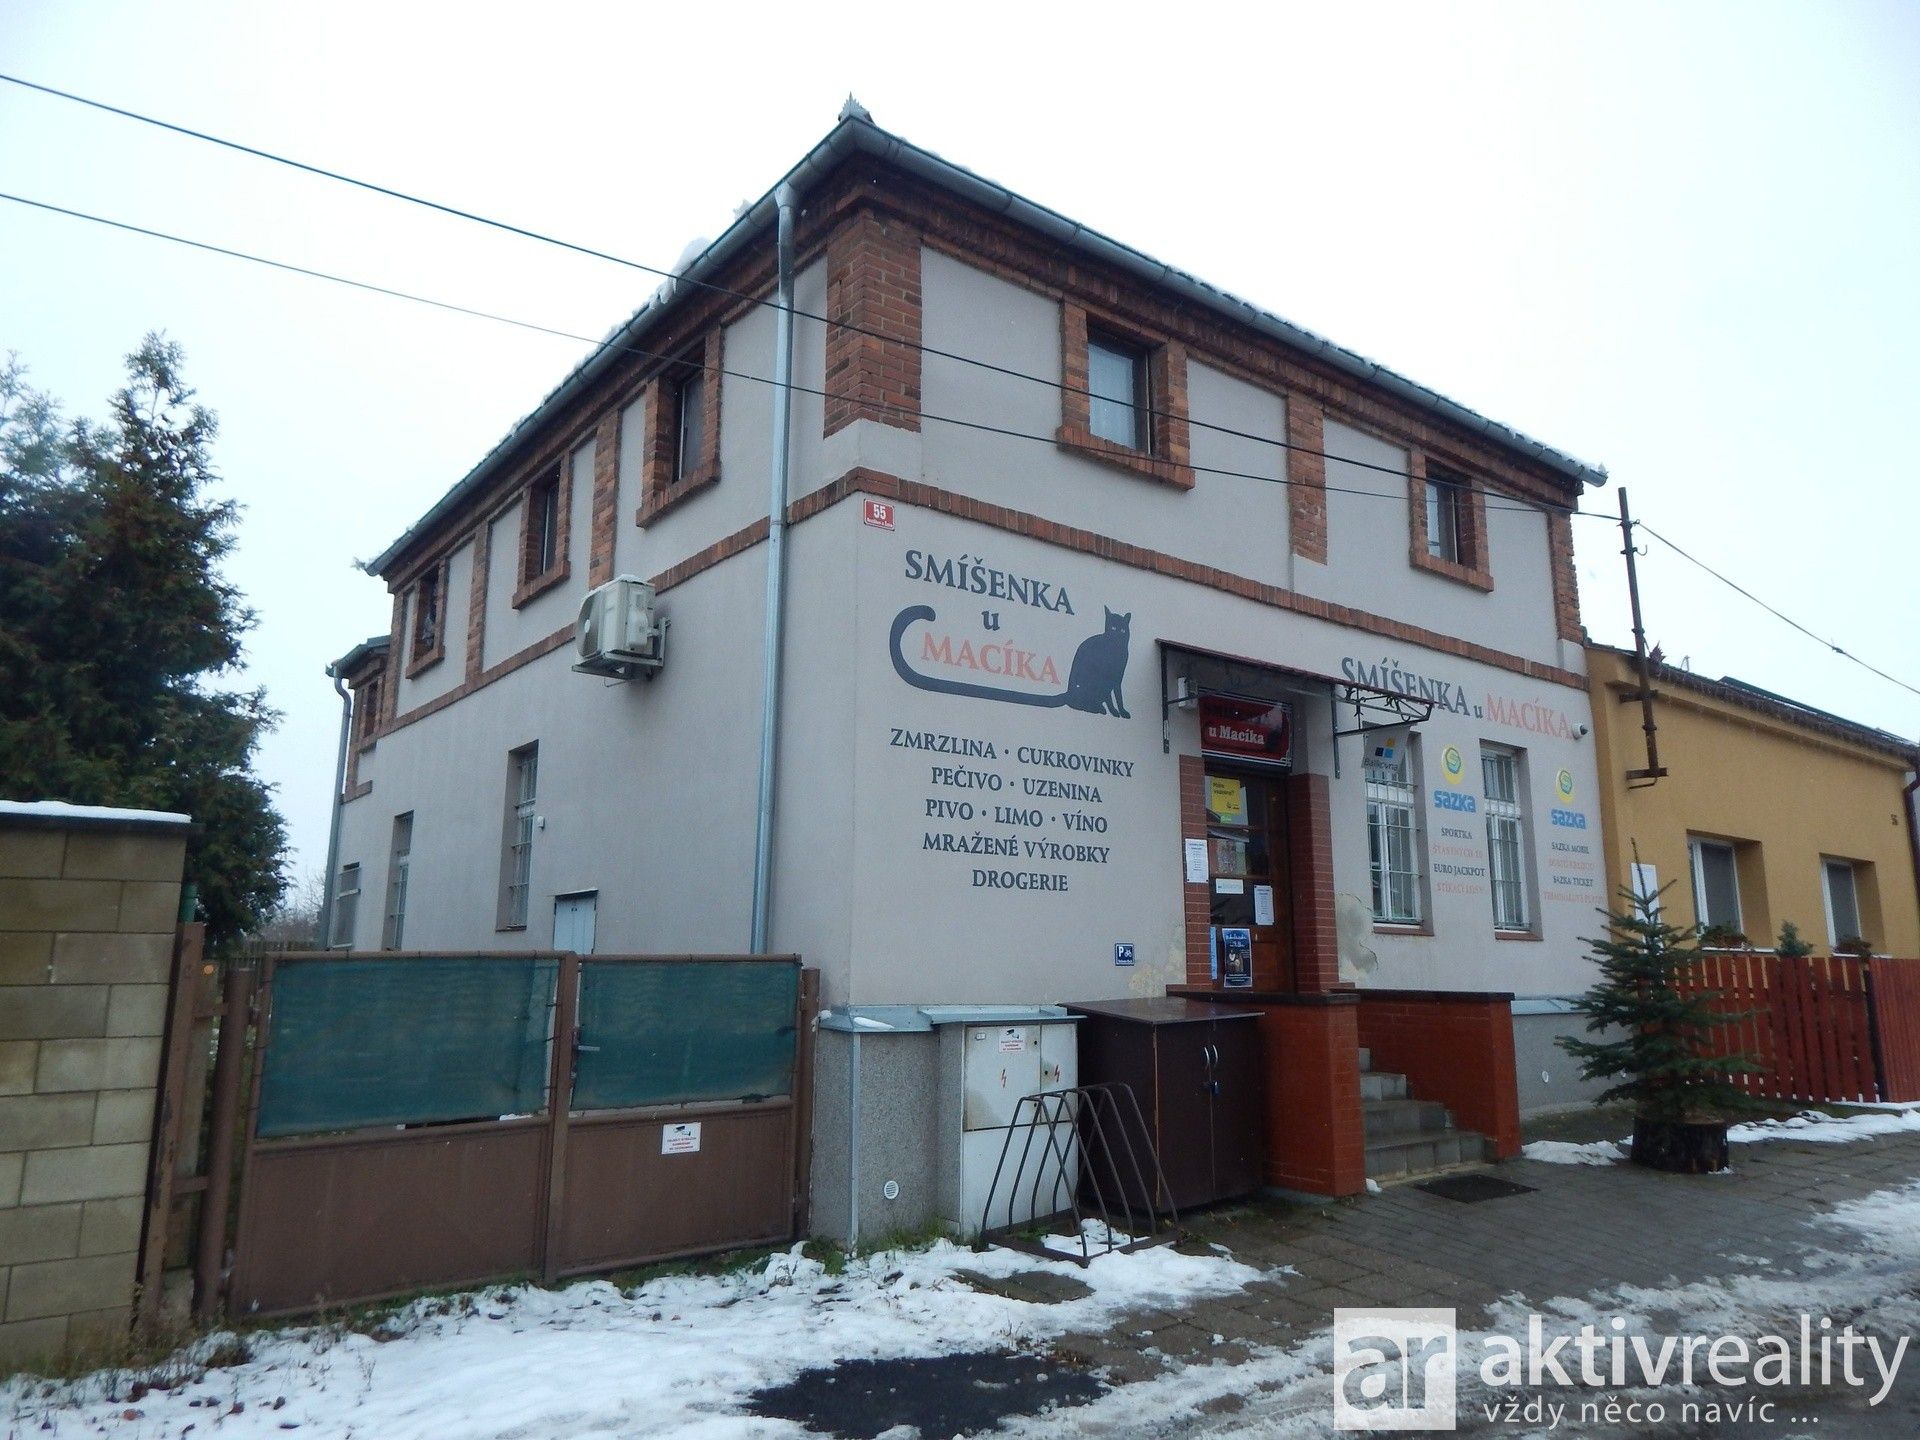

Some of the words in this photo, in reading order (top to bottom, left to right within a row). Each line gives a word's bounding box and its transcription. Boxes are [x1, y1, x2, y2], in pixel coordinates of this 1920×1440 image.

[873, 503, 887, 520] 55
[905, 549, 1076, 616] SMÍŠENKA
[981, 608, 1001, 632] u
[920, 631, 1062, 685] MACÍKA
[1341, 656, 1471, 716] SMÍŠENKA
[1473, 704, 1484, 719] u
[1486, 691, 1575, 740] MACÍKA
[1208, 726, 1217, 738] u
[1219, 725, 1265, 745] Macíka
[890, 728, 998, 759] ZMRZLINA
[1017, 746, 1135, 778] CUKROVINKY
[931, 765, 1003, 792] PEČIVO
[1022, 778, 1103, 803] UZENINA
[1433, 790, 1477, 813] sazka
[925, 799, 974, 821] PIVO
[994, 806, 1043, 828] LIMO
[1062, 810, 1108, 834] VÍNO
[1551, 809, 1587, 830] sazka
[1441, 827, 1473, 840] SPORTKA
[922, 831, 1020, 857] MRAŽENÉ
[1023, 837, 1111, 864] VÝROBKY
[1551, 841, 1570, 852] SAZKA
[972, 869, 1069, 892] DROGERIE
[1433, 863, 1453, 874] EURO
[1454, 865, 1486, 877] JACKPOT
[1553, 875, 1571, 885] SAZKA
[1572, 877, 1593, 887] TICKET
